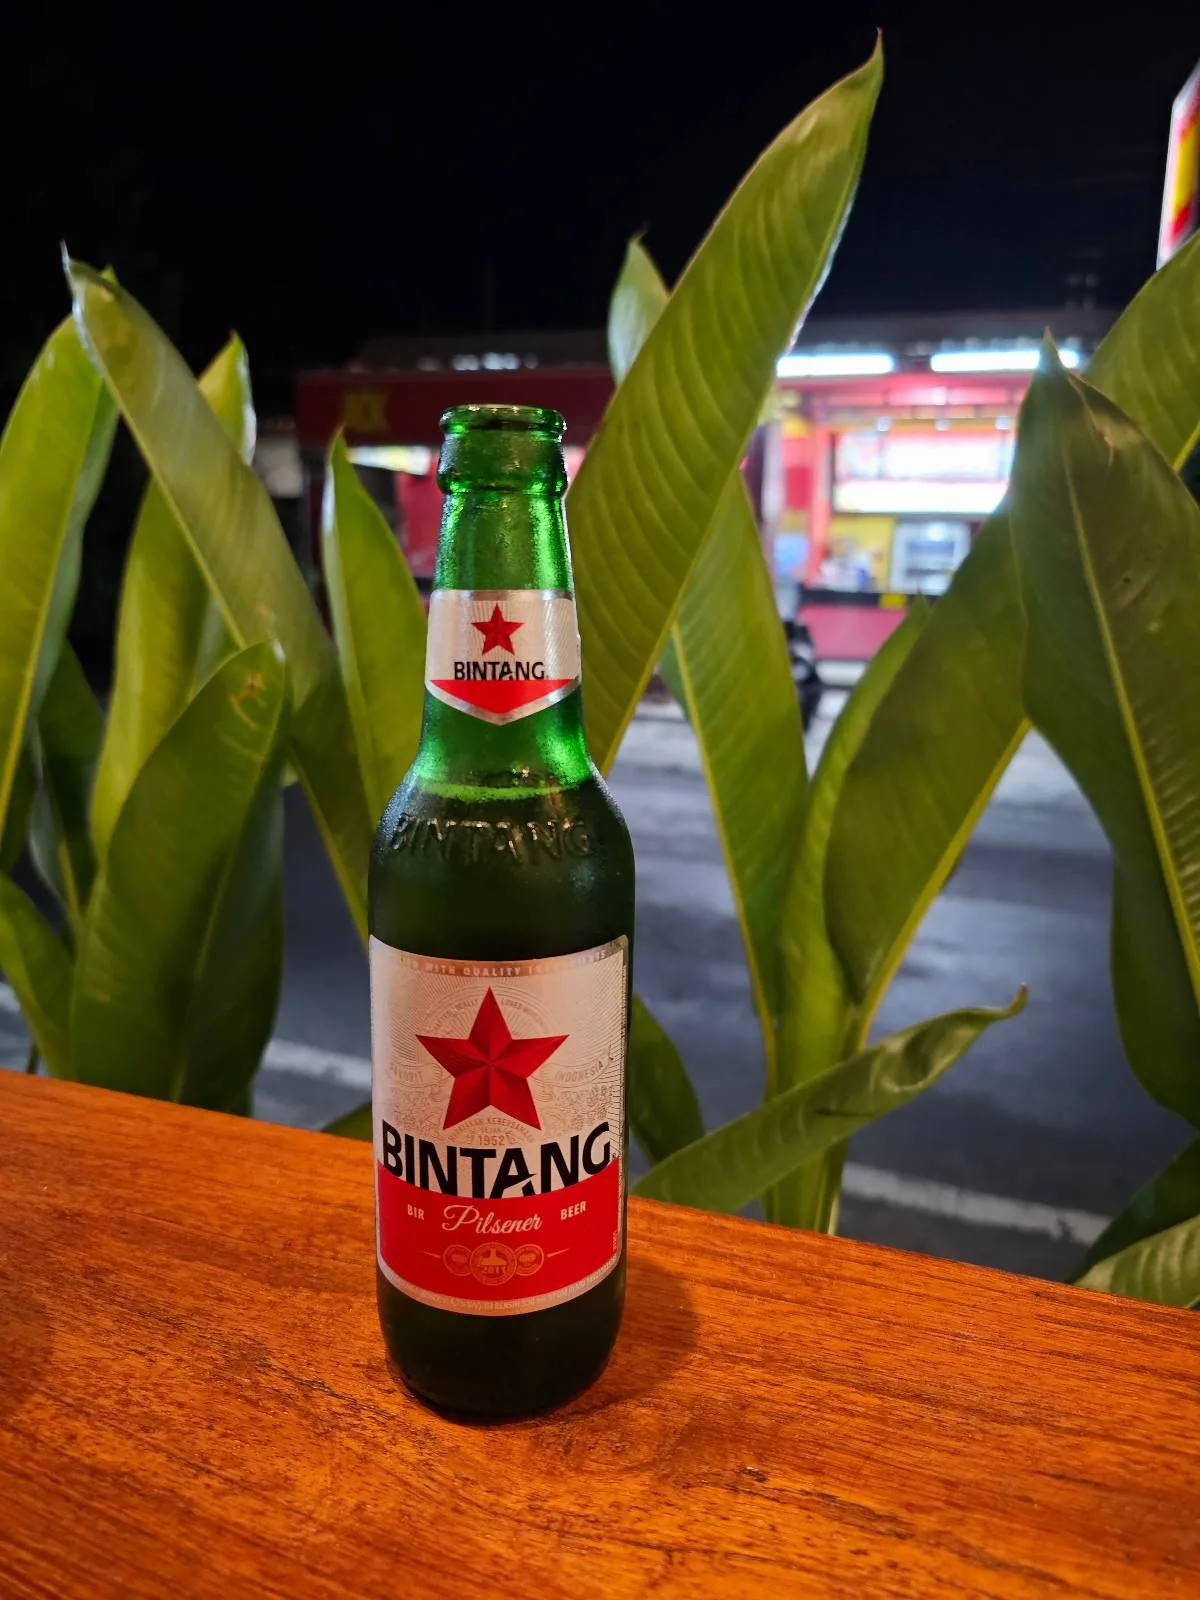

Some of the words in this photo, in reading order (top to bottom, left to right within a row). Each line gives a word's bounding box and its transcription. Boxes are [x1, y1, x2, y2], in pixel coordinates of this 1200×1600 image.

[454, 660, 545, 681] BINTANG
[391, 812, 592, 865] BINTANG
[424, 962, 456, 975] WITH
[463, 966, 521, 977] QUALITY
[478, 1135, 505, 1146] 1952
[382, 1119, 610, 1199] BINTANG
[407, 1203, 425, 1221] BIR
[441, 1204, 542, 1234] Pilsener
[560, 1200, 587, 1222] BEER
